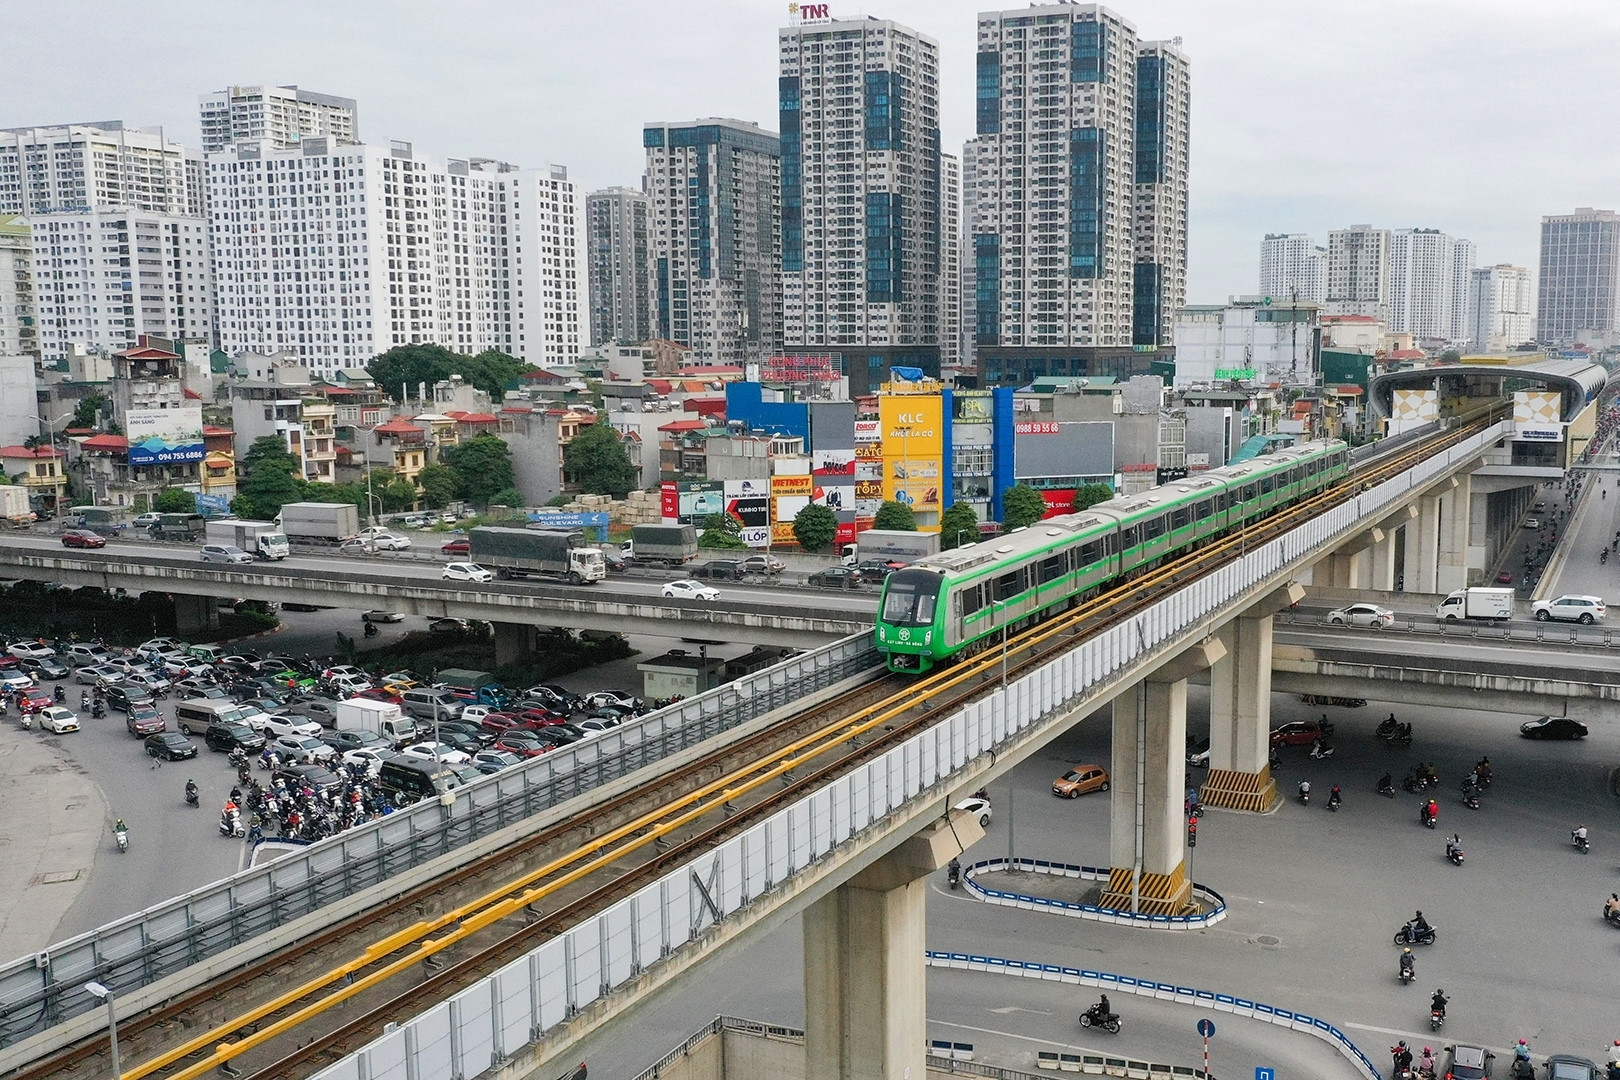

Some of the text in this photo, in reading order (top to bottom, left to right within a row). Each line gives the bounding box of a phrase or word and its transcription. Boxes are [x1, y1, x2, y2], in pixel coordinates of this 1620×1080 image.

[800, 4, 830, 19] TNR
[898, 413, 924, 423] KLC
[1016, 424, 1032, 433] 0988
[1032, 424, 1040, 432] 59
[1041, 424, 1050, 432] 55
[158, 453, 172, 461] 094
[173, 452, 185, 460] 755
[185, 451, 203, 459] 6886
[772, 478, 810, 487] VIETNEST
[748, 530, 767, 541] LỐP
